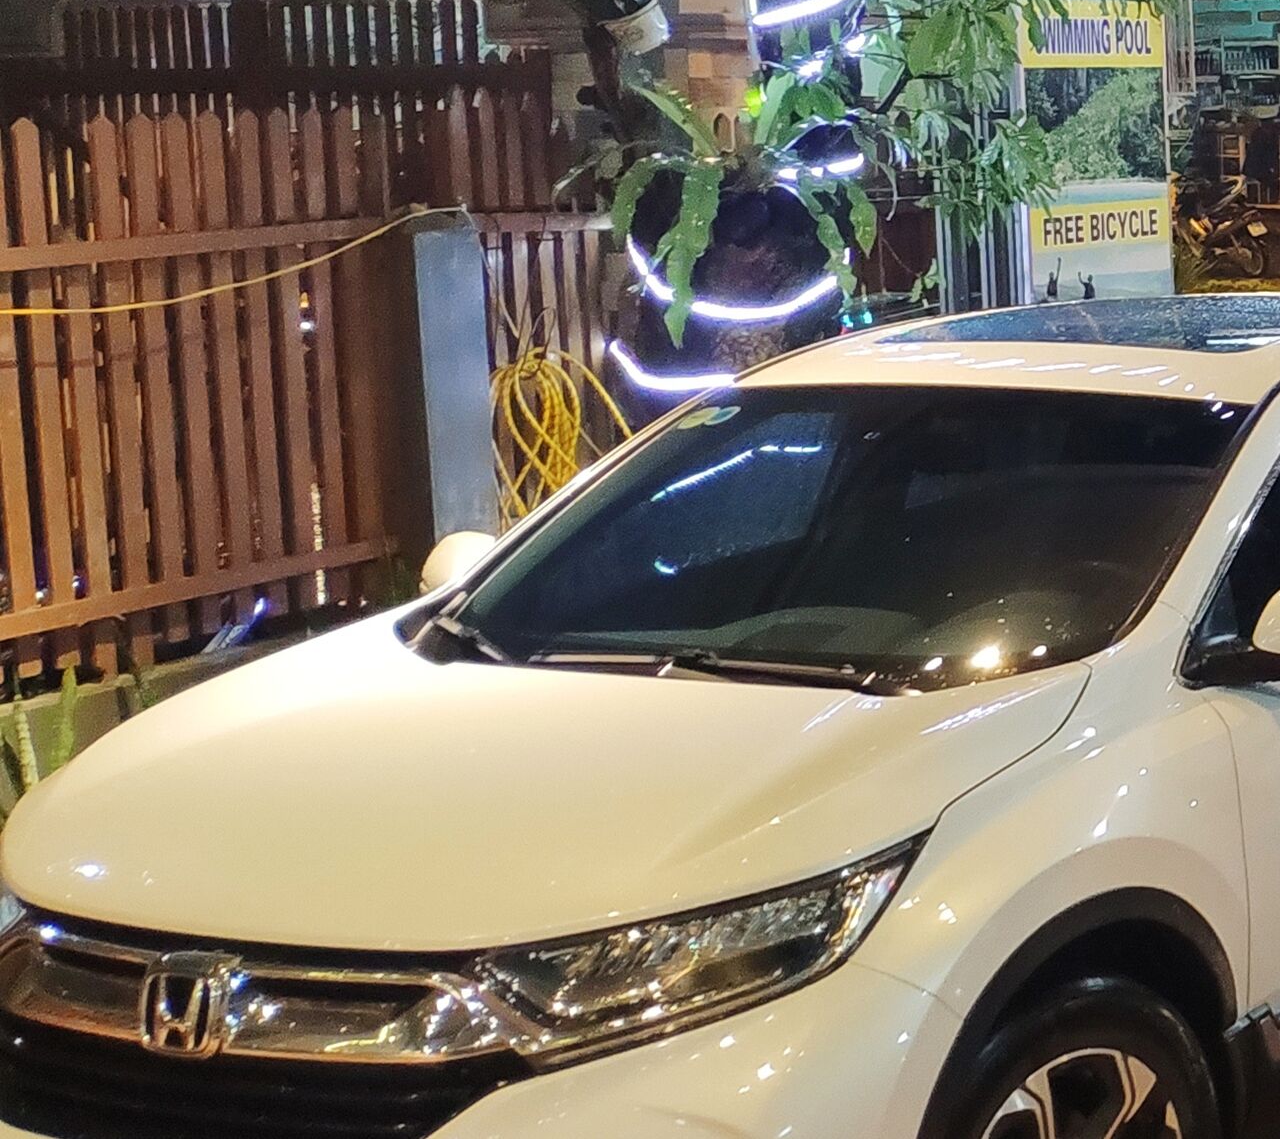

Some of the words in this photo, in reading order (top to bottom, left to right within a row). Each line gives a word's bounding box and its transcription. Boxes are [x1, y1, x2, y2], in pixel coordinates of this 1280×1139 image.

[1036, 18, 1110, 54] WIMMING
[1115, 20, 1151, 54] POOL
[1043, 214, 1084, 245] FREE
[1090, 207, 1159, 241] BICYCLE
